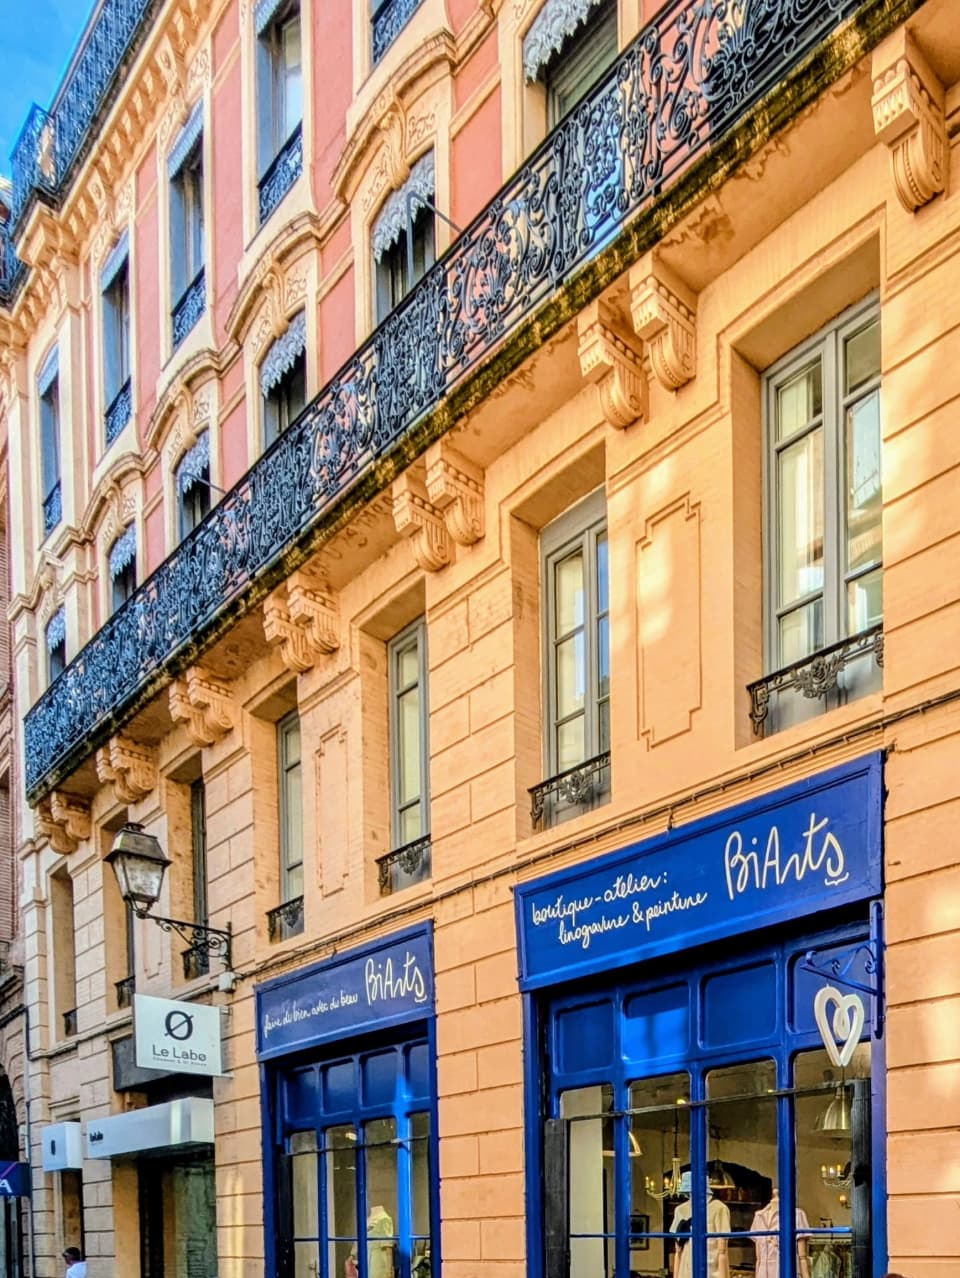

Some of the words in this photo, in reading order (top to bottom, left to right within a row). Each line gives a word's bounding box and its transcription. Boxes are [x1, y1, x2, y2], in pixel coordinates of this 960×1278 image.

[724, 812, 849, 900] BiArts
[632, 901, 644, 924] &
[646, 891, 708, 931] peinture
[365, 951, 428, 1005] BiArts
[282, 1008, 292, 1025] du
[152, 1044, 170, 1057] Le
